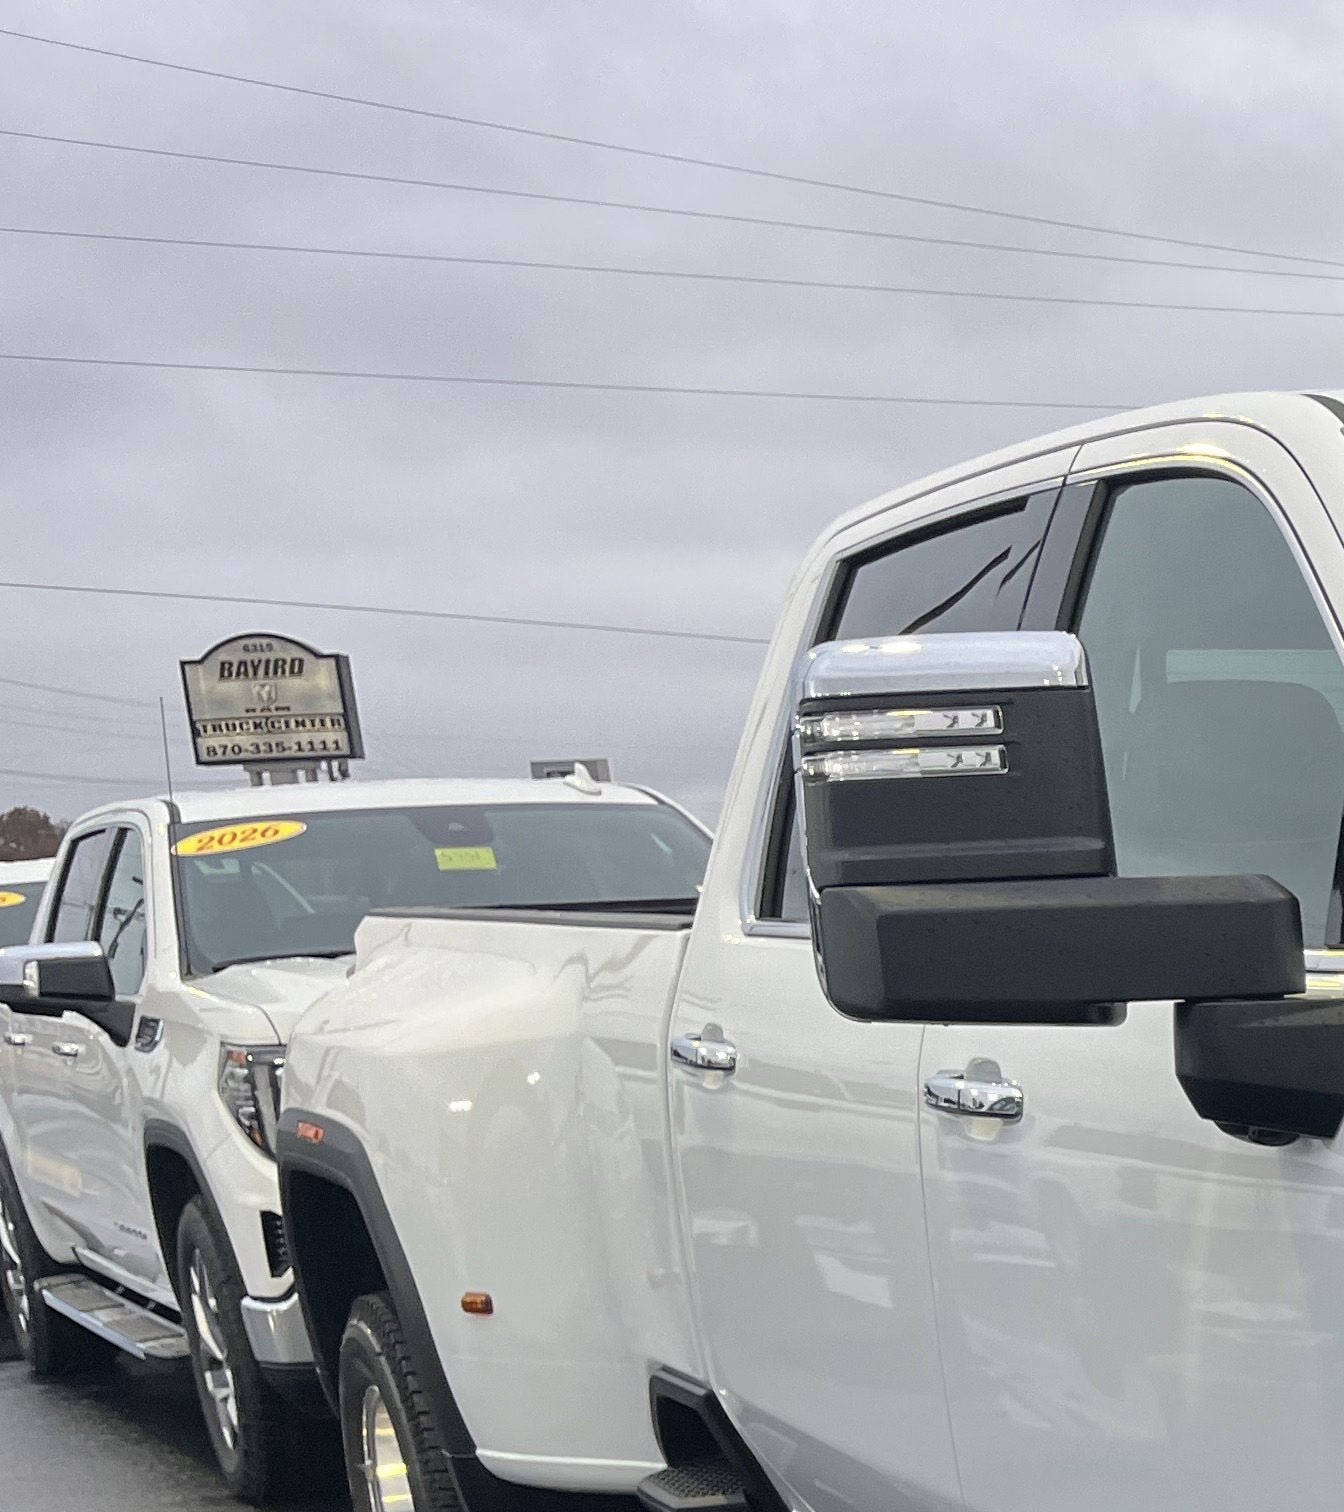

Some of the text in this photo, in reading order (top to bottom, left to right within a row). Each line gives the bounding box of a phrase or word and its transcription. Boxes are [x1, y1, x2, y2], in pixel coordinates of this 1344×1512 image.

[218, 656, 305, 679] BAYIRD
[201, 717, 342, 734] TRUCK CENTER
[205, 738, 342, 758] 870-335-1111
[195, 825, 280, 853] 2026
